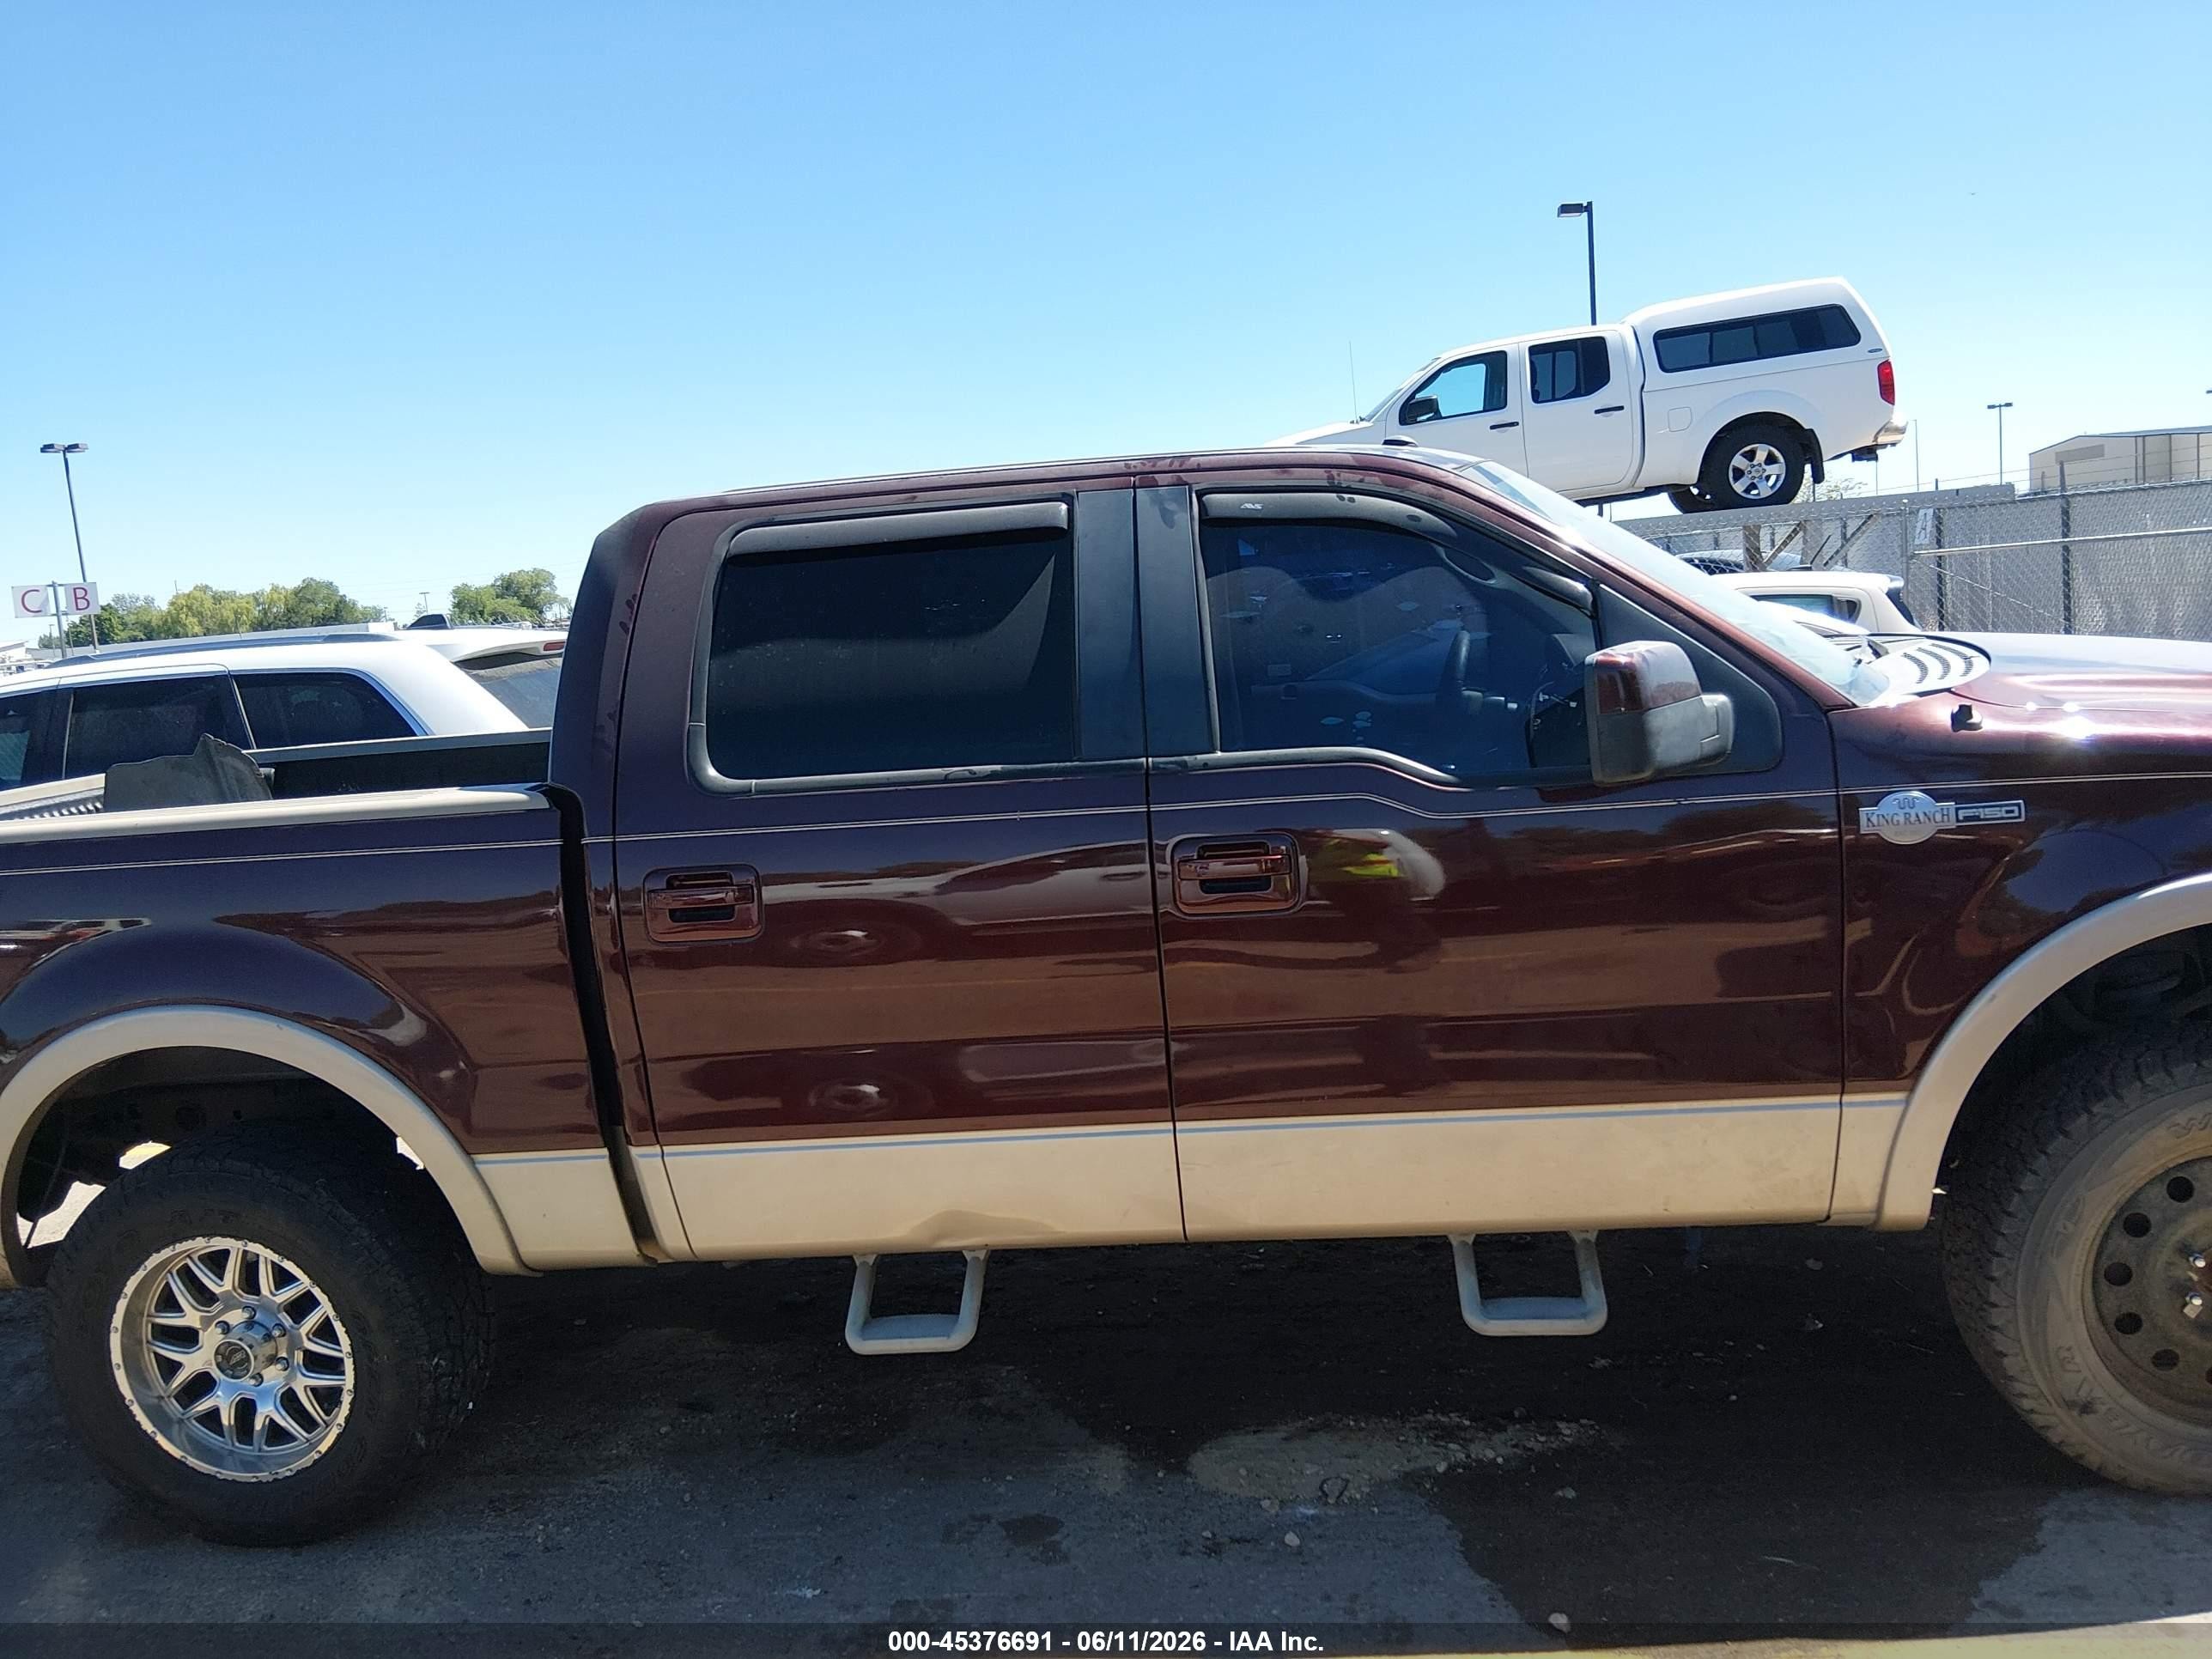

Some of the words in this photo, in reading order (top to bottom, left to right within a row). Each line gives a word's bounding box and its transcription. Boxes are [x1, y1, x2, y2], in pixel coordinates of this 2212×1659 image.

[21, 589, 43, 614] C
[72, 586, 91, 611] B
[1865, 811, 1900, 828] KING
[1903, 807, 1952, 825] RANCH
